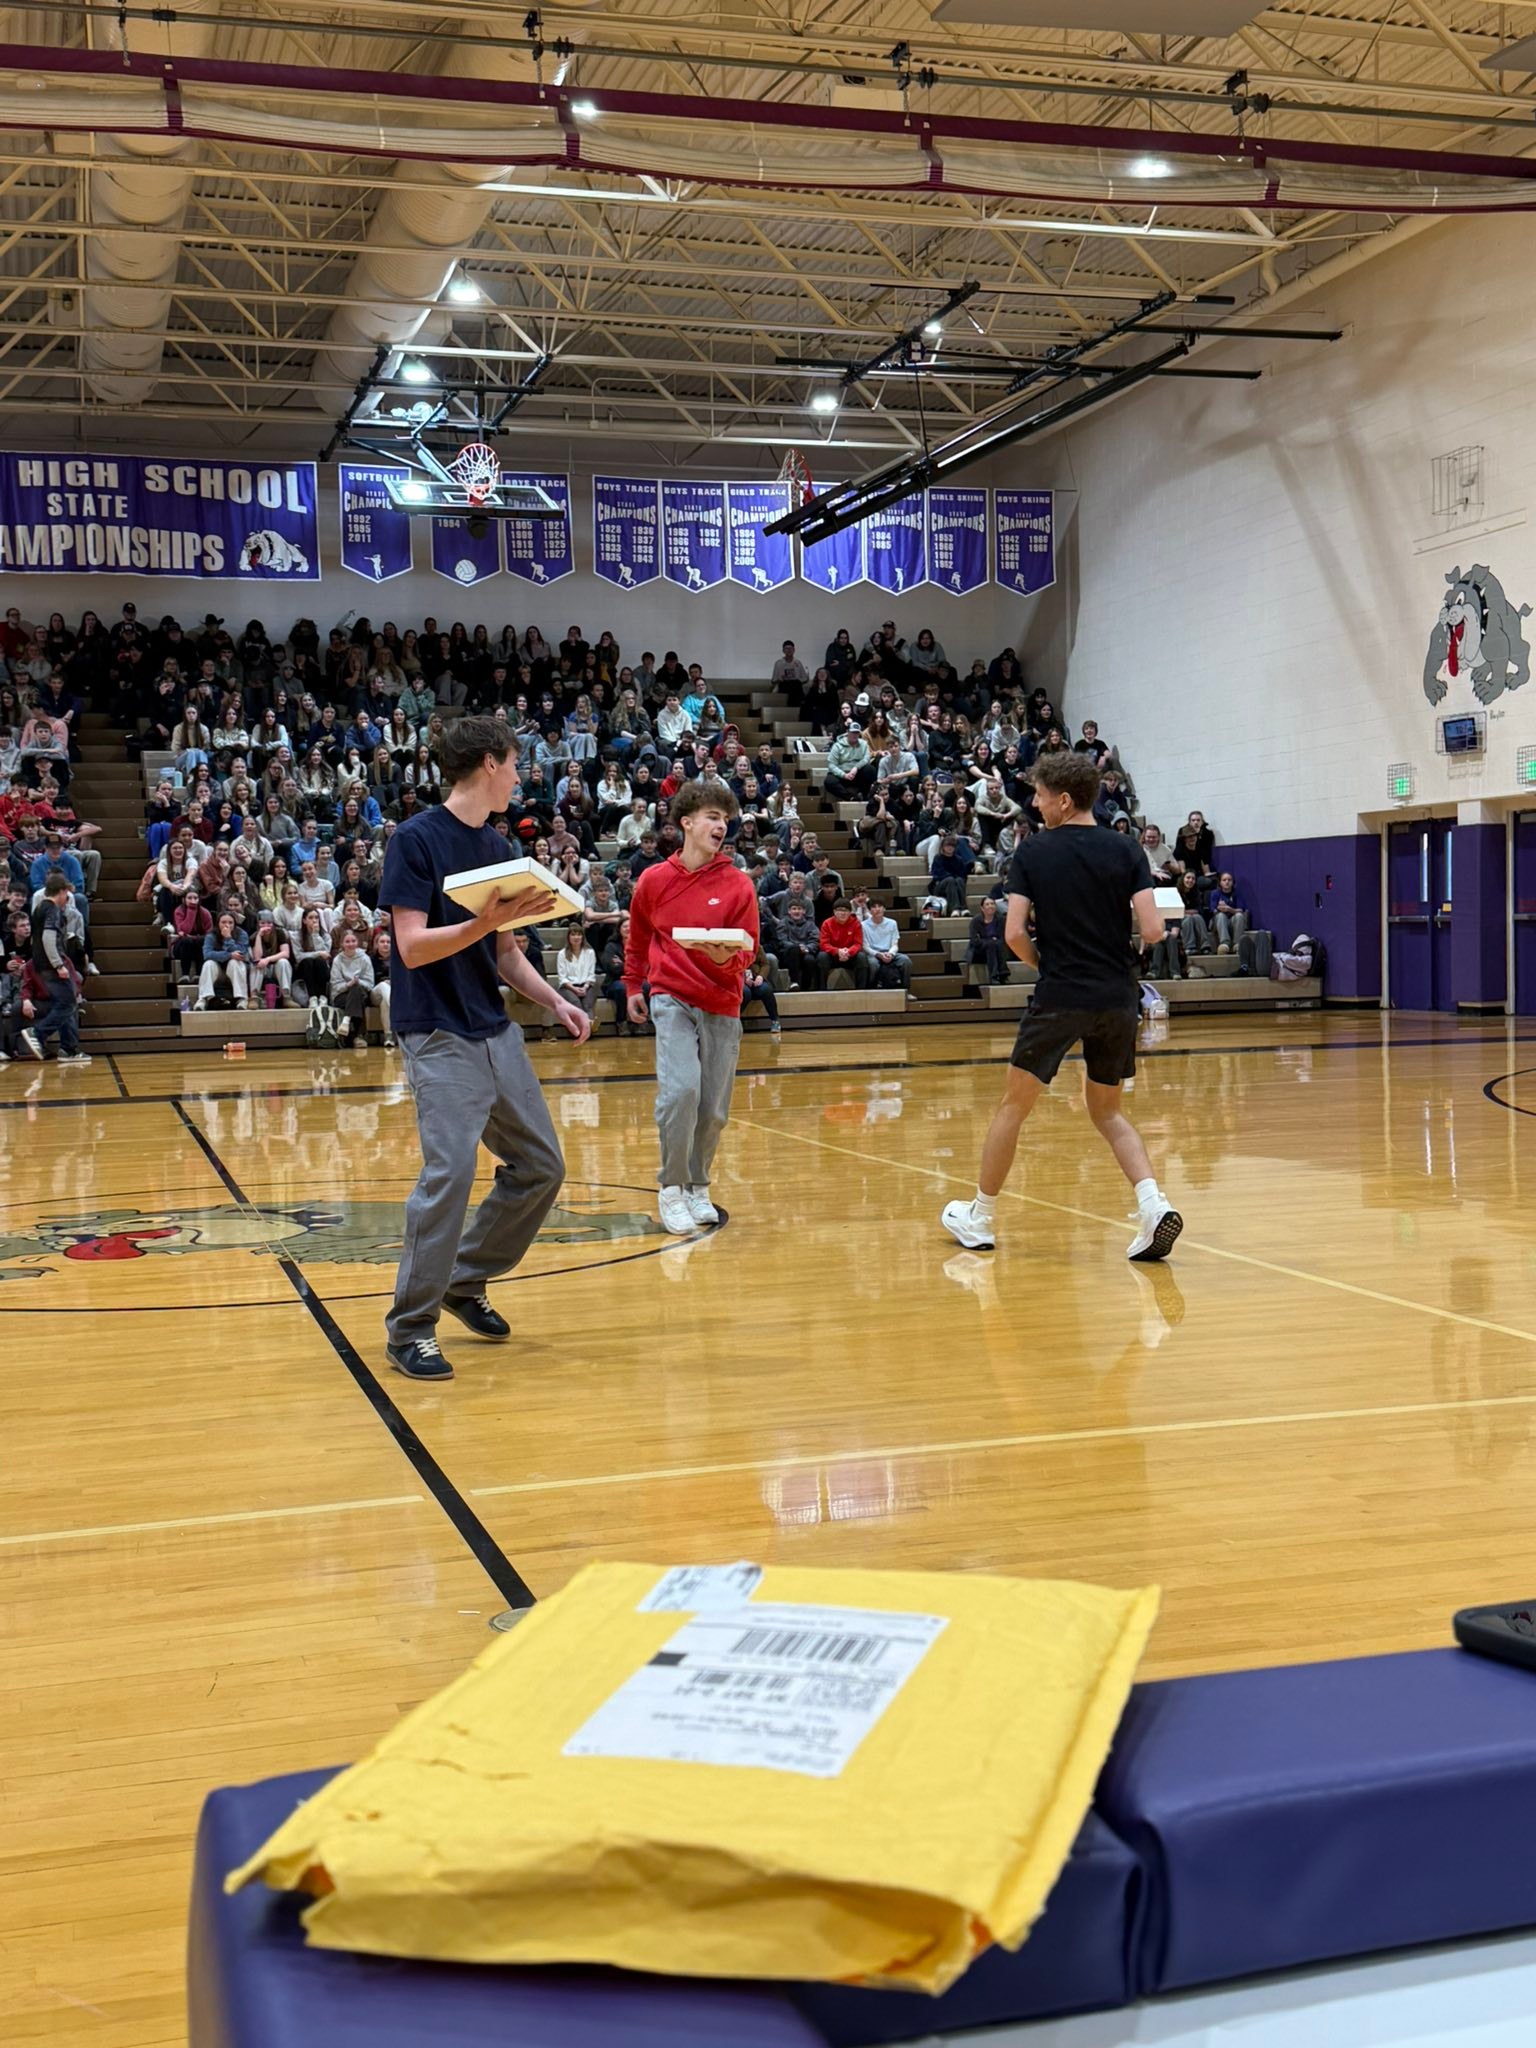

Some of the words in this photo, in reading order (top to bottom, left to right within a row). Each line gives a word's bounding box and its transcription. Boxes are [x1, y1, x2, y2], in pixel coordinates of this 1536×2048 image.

[348, 472, 401, 482] SOFTBALL
[17, 459, 119, 488] HIGH
[144, 464, 308, 514] SCHOOL
[534, 480, 566, 488] TRACK
[597, 483, 621, 491] BOYS
[625, 485, 656, 493] TRACK
[664, 487, 688, 495] BOYS
[692, 488, 722, 496] TRACK
[730, 488, 755, 496] GIRLS
[47, 492, 128, 518] STATE
[597, 501, 656, 525] CHAMPIONS
[664, 505, 722, 527] CHAMPIONS
[347, 514, 371, 523] 1992
[868, 511, 922, 531] CHAMPIONS
[931, 512, 985, 533] CHAMPIONS
[543, 521, 565, 529] 1921
[998, 513, 1051, 534] CHAMPIONS
[347, 524, 371, 533] 1995
[348, 533, 372, 543] 2011
[544, 531, 566, 539] 1924
[600, 534, 621, 543] 1931
[1000, 535, 1020, 543] 1942
[544, 540, 566, 549] 1925
[632, 536, 654, 545] 1937
[600, 543, 622, 552] 1933
[668, 547, 689, 555] 1974
[1000, 544, 1020, 552] 1943
[544, 550, 566, 558] 1927
[600, 552, 622, 562] 1935
[632, 554, 654, 563] 1943
[668, 556, 690, 565] 1975
